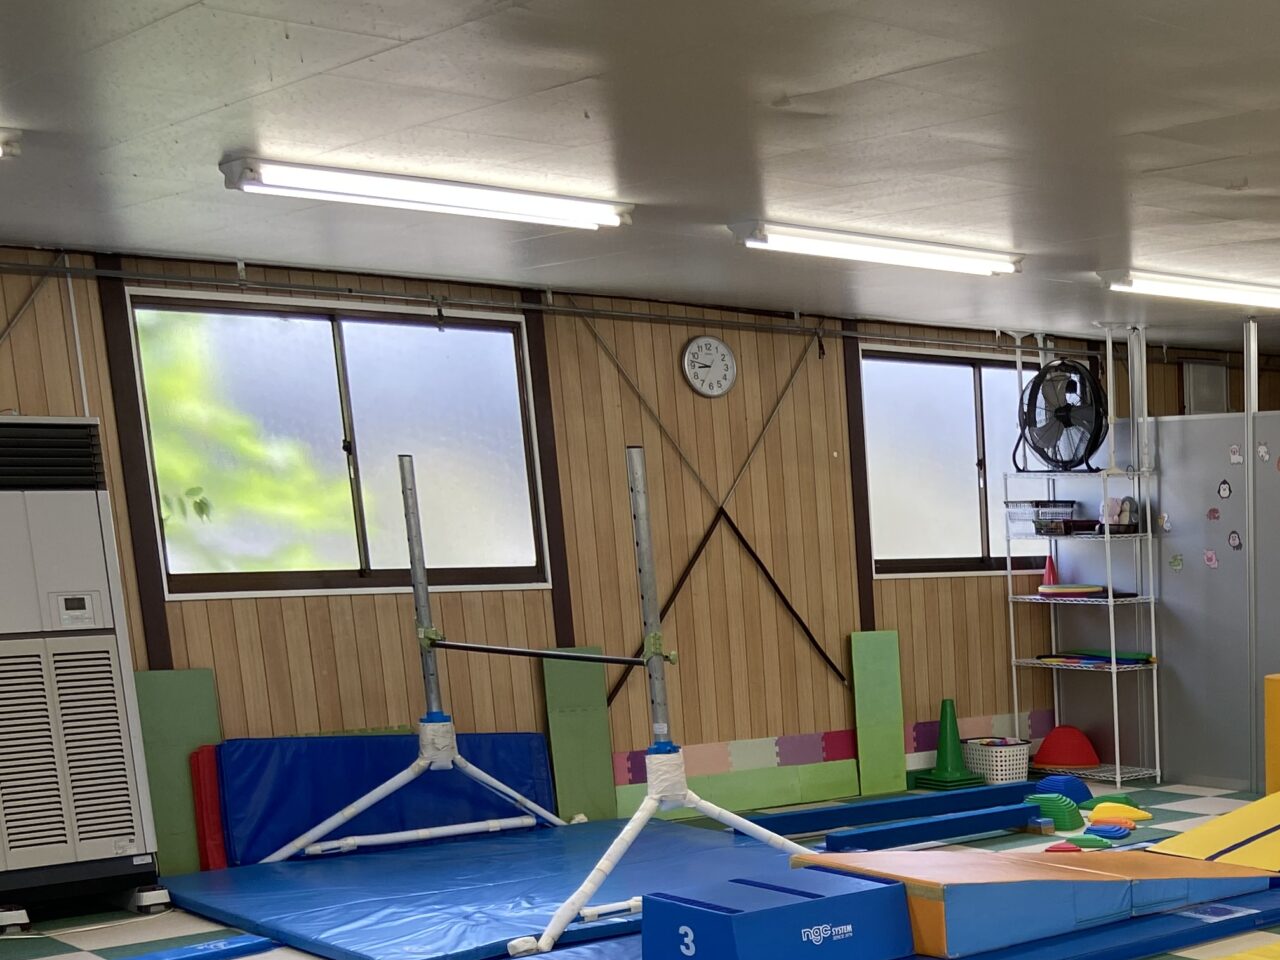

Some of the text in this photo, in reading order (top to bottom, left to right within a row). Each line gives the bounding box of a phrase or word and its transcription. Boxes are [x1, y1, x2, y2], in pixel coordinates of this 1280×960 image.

[704, 343, 712, 351] 12
[715, 346, 719, 354] 1
[692, 352, 699, 360] 10
[720, 353, 726, 361] 2
[690, 361, 696, 370] 9
[723, 363, 729, 372] 3
[693, 371, 699, 380] 8
[722, 373, 727, 381] 4
[700, 379, 705, 388] 7
[708, 382, 714, 391] 6
[716, 380, 722, 388] 5
[801, 924, 853, 945] ngc SYSTEM
[678, 925, 696, 957] 3
